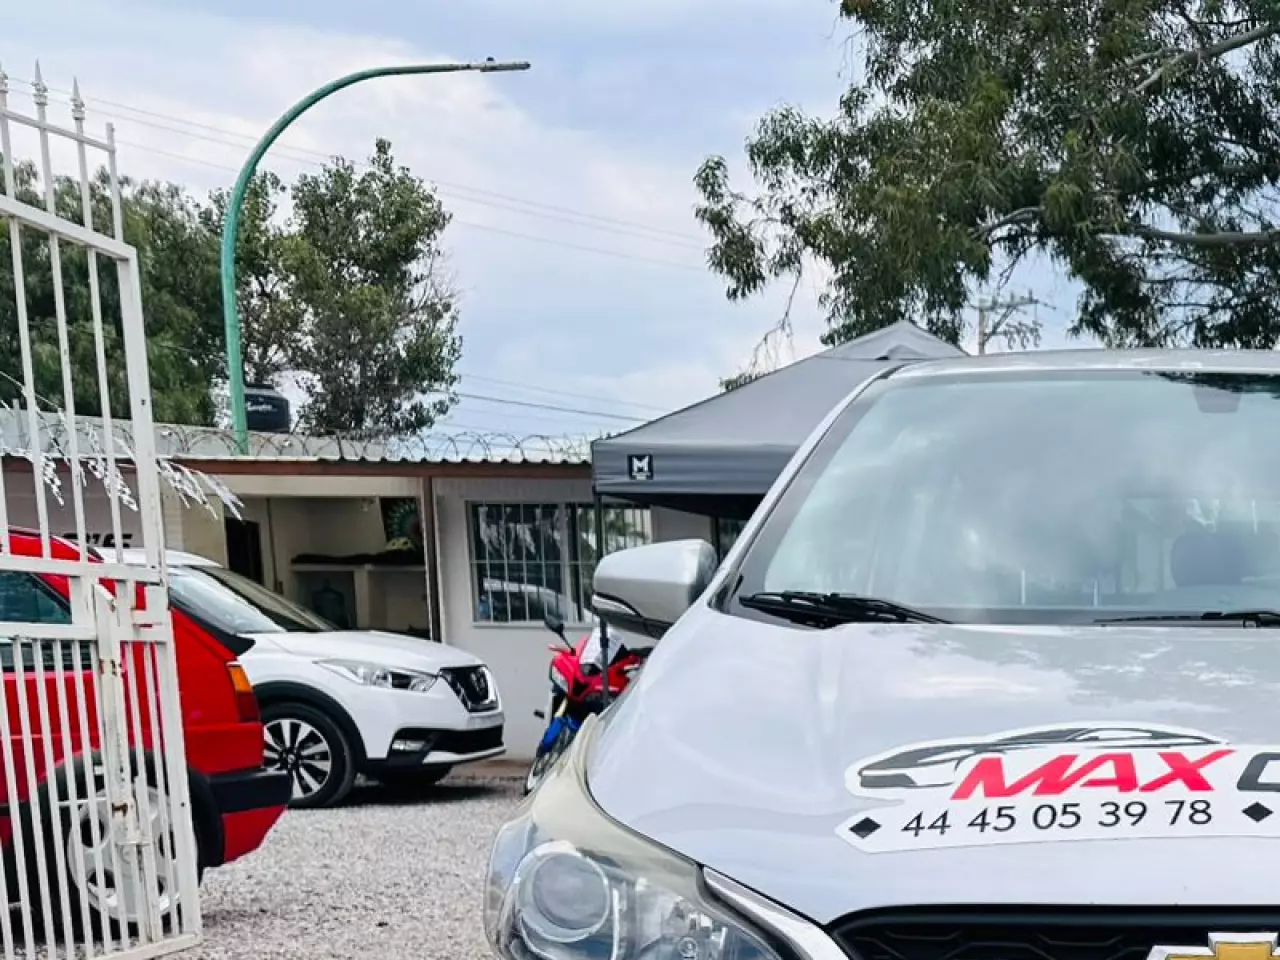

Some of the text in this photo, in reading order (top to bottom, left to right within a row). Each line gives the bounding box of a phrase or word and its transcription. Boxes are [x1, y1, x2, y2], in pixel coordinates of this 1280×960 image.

[951, 749, 1237, 800] MAX
[901, 810, 952, 837] 44
[967, 805, 1017, 833] 45
[1032, 803, 1082, 830] 05
[1098, 801, 1148, 828] 39
[1164, 799, 1213, 826] 78
